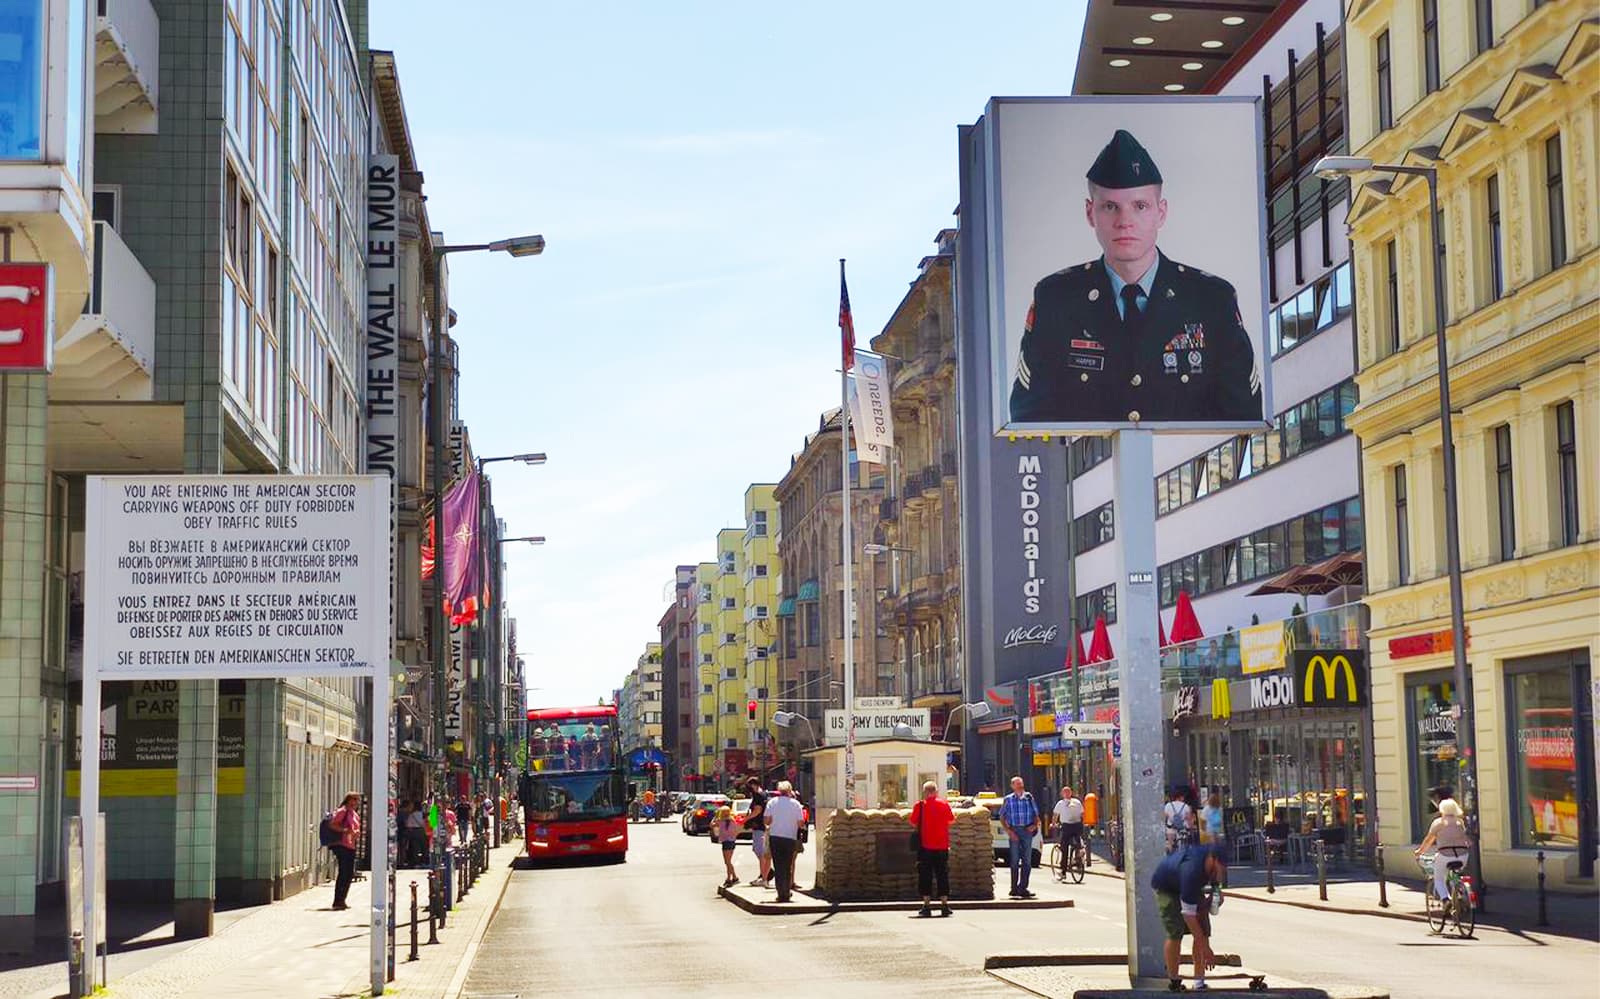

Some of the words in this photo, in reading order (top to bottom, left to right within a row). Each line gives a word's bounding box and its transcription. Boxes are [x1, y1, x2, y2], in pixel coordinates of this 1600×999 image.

[368, 165, 395, 231] MUR
[368, 241, 395, 268] LE
[368, 284, 394, 360] WALL
[368, 369, 394, 419] THE
[125, 485, 145, 498] YOU
[152, 485, 171, 497] ARE
[178, 485, 227, 498] ENTERING
[233, 485, 249, 497] THE
[256, 485, 310, 497] AMERICAN
[316, 484, 355, 497] SECTOR
[123, 501, 178, 513] CARRYING
[183, 501, 235, 513] WEAPONS
[240, 500, 258, 513] OFF
[265, 500, 291, 512] DUTY
[297, 500, 354, 512] FORBIDDEN
[184, 516, 212, 528] OBEY
[218, 516, 259, 528] TRAFFIC
[266, 516, 297, 528] RULES
[1018, 455, 1045, 614] McDonald's
[129, 540, 145, 553] ВЫ
[211, 540, 217, 552] В
[223, 538, 307, 552] АМЕРИКАНСКИЙ
[312, 539, 350, 552] СЕКТОР
[119, 556, 153, 569] НОСИТЬ
[156, 556, 191, 569] ОРУЖИЕ
[252, 555, 258, 568] В
[329, 555, 358, 568] ВРЕМЯ
[213, 571, 275, 583] ДОРОЖНЫМ
[283, 571, 340, 583] ПРАВИЛАМ
[119, 596, 146, 608] VOUS
[153, 595, 190, 608] ENTREZ
[197, 595, 225, 607] DANS
[231, 595, 239, 606] LE
[247, 594, 291, 607] SECTEUR
[118, 610, 154, 623] DEFENSE
[157, 610, 168, 623] DE
[170, 610, 202, 622] PORTER
[205, 610, 220, 622] DES
[223, 610, 251, 622] ARMES
[255, 610, 266, 621] EN
[270, 609, 304, 621] DEHORS
[308, 609, 319, 621] DU
[322, 608, 357, 621] SERVICE
[130, 625, 181, 638] OBEISSEZ
[188, 626, 209, 637] AUX
[216, 624, 252, 637] REGLES
[259, 625, 270, 636] DE
[277, 624, 343, 636] CIRCULATION
[118, 651, 132, 665] SIE
[140, 651, 189, 664] BETRETEN
[195, 650, 214, 664] DEN
[220, 649, 310, 664] AMERIKANISCHEN
[316, 648, 355, 662] SEKTOR
[831, 717, 844, 728] US
[874, 715, 924, 728] CHECKPOINT
